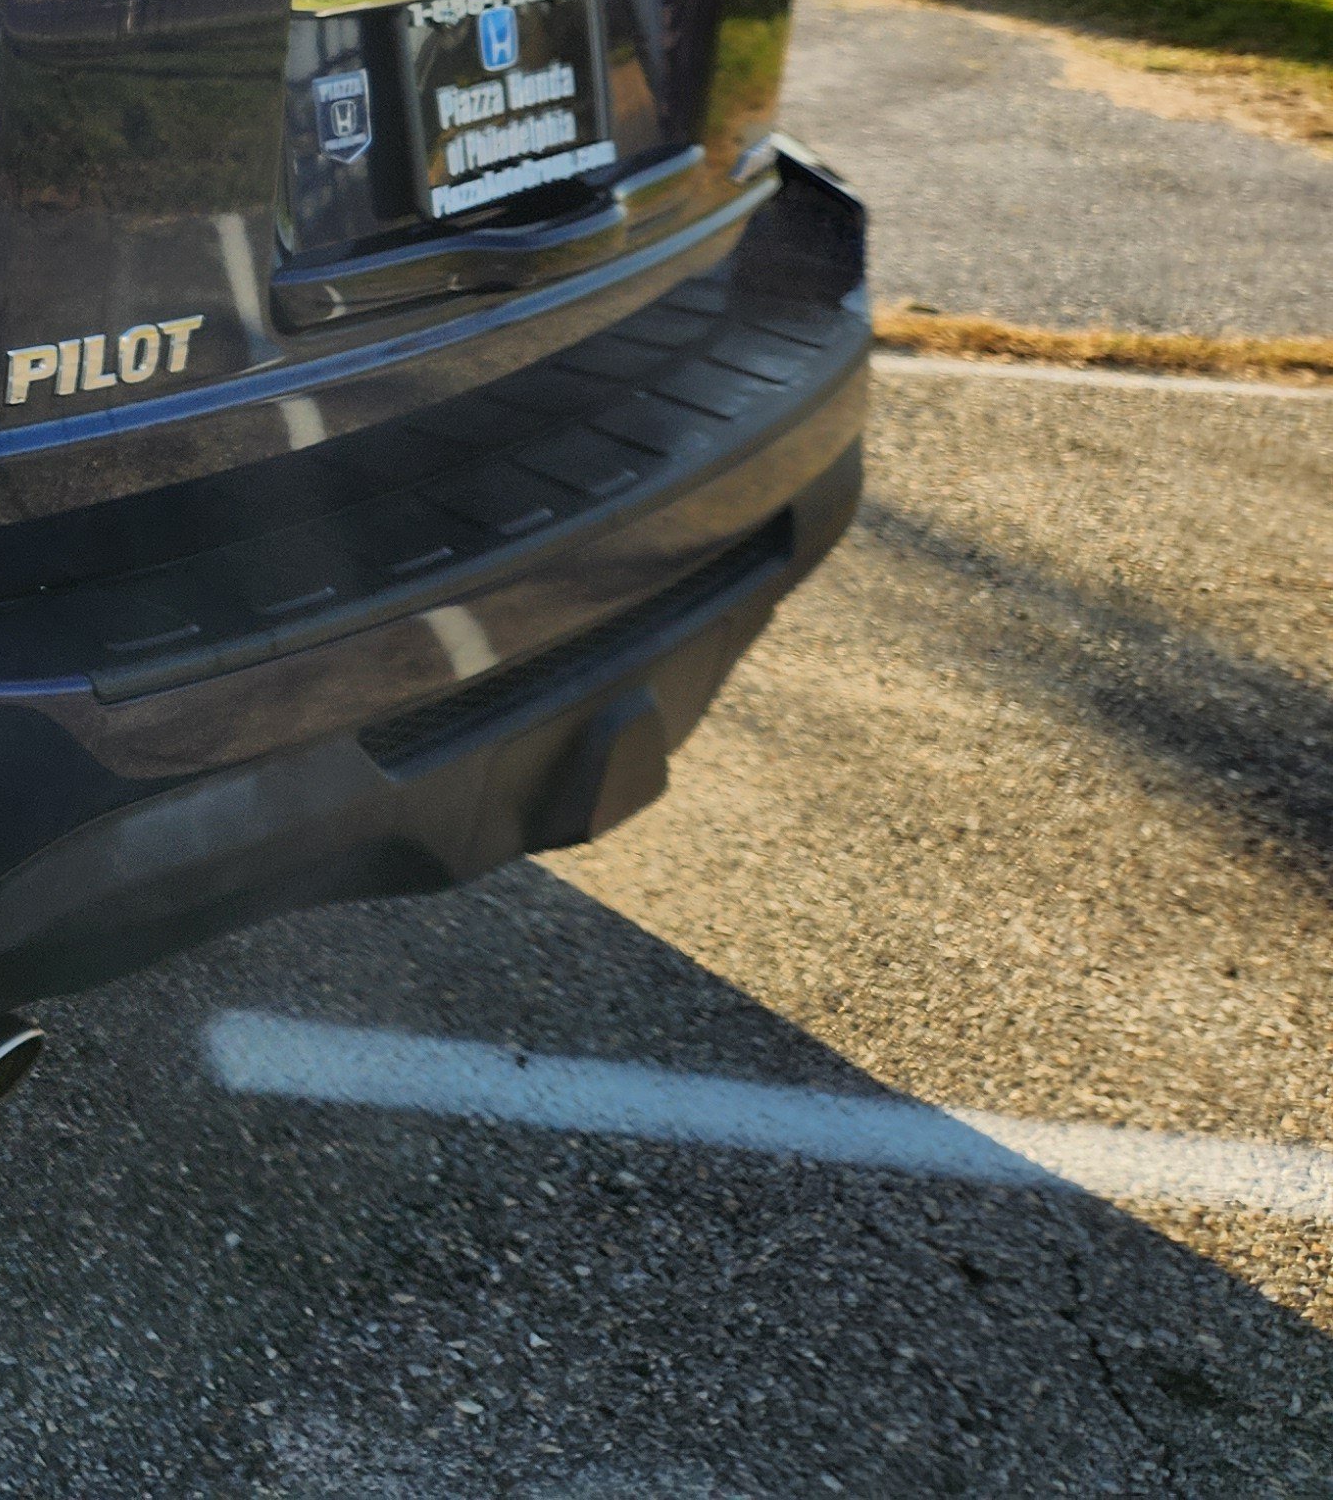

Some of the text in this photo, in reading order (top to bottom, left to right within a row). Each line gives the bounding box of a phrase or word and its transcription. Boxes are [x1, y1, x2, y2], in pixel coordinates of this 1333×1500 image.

[436, 60, 576, 131] Piazza Honda
[465, 109, 577, 171] Philadelphia
[5, 314, 205, 405] PILOT
